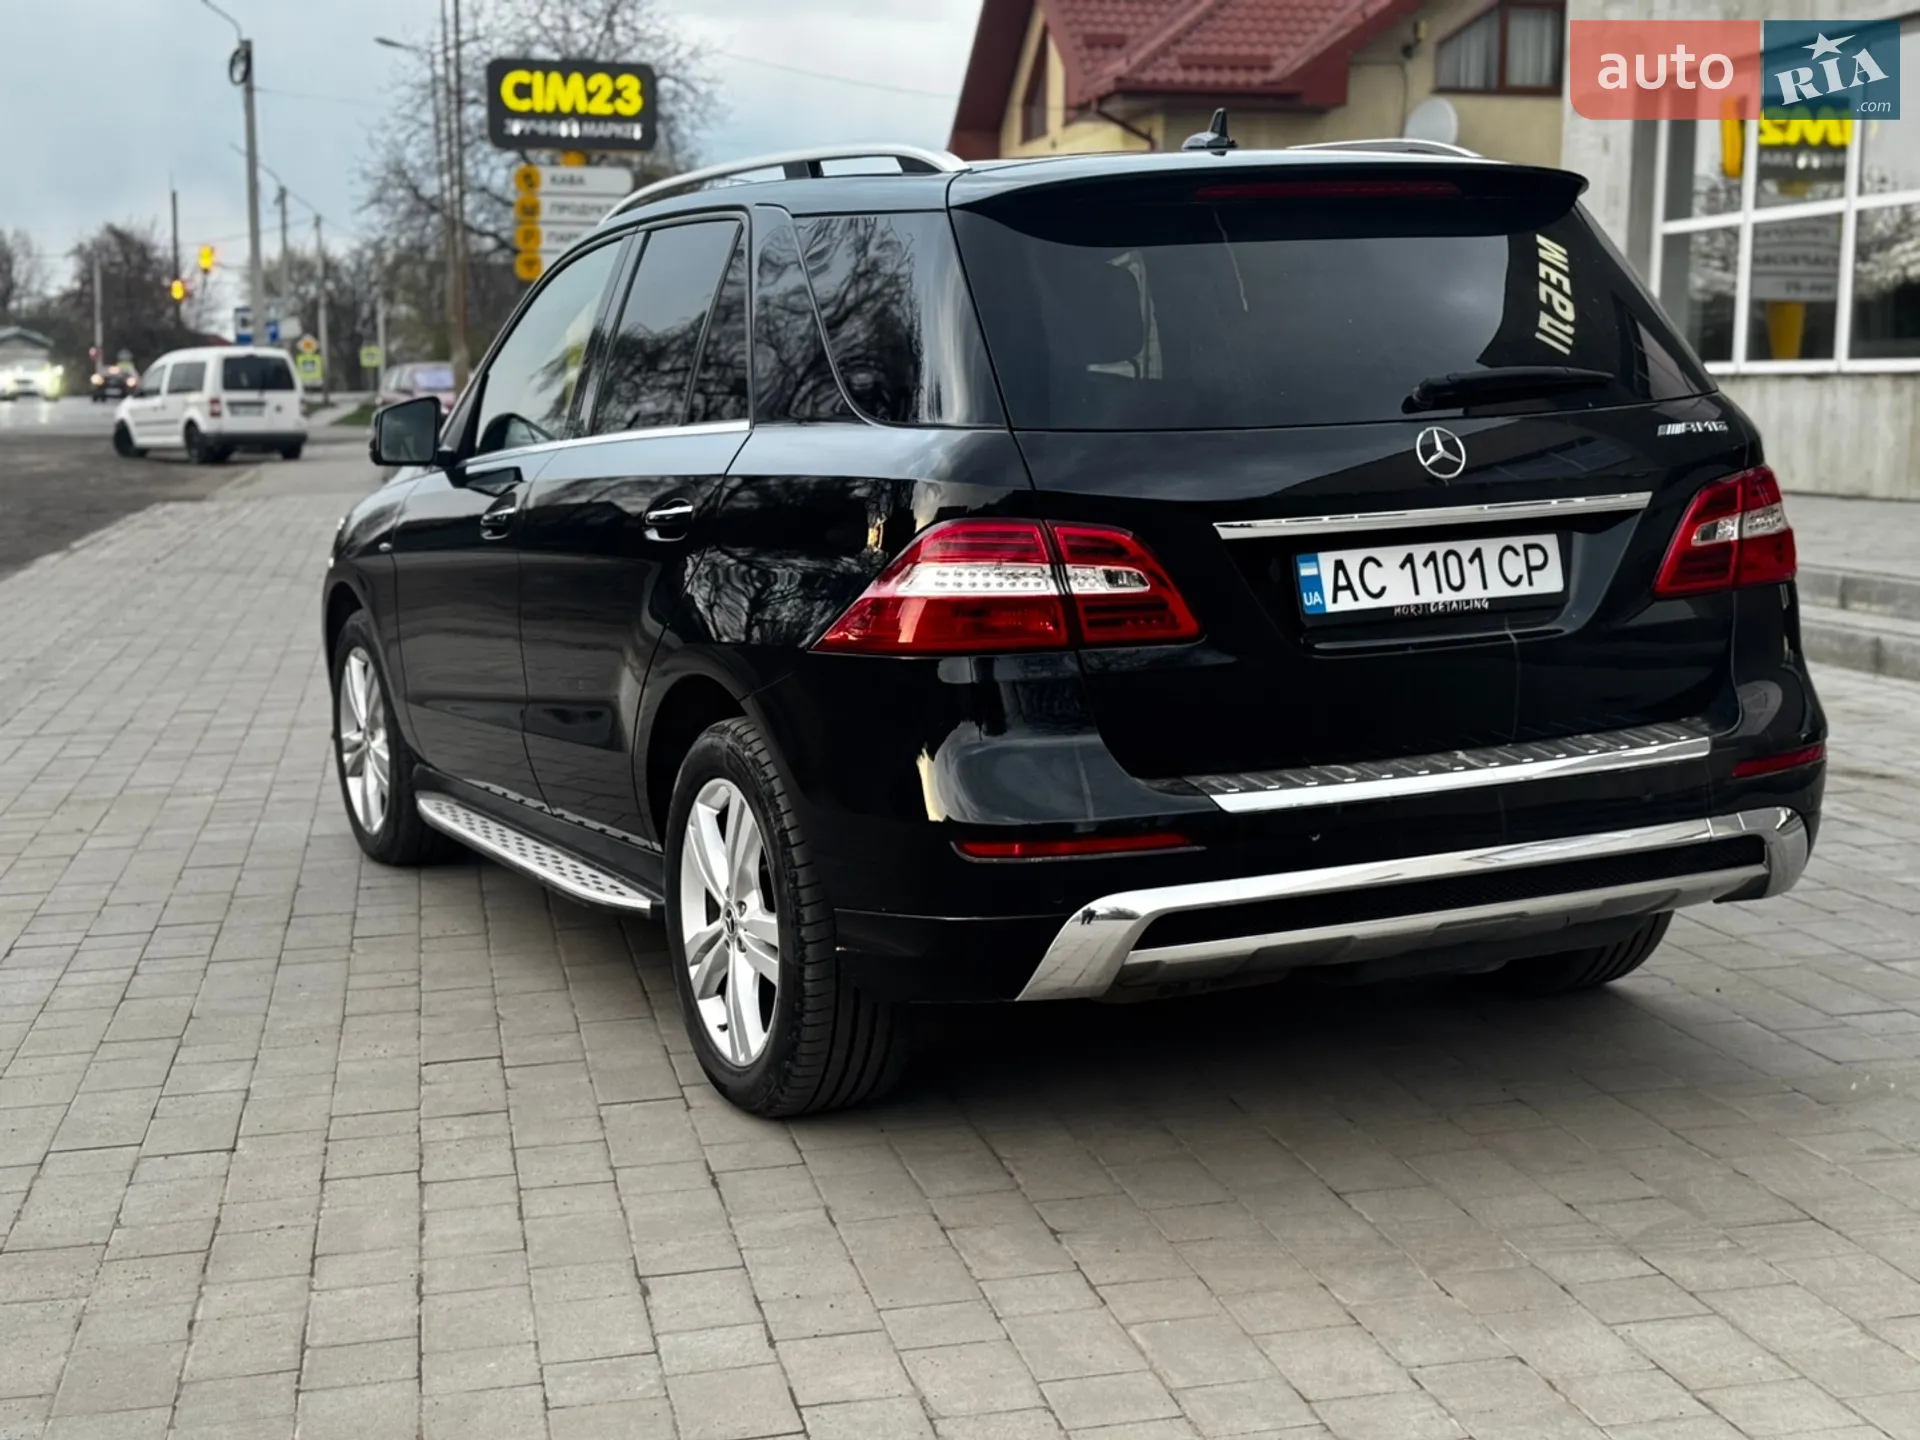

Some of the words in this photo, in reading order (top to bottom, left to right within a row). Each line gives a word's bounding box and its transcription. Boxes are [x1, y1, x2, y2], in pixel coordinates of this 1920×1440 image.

[550, 173, 586, 186] КАВА
[1331, 555, 1387, 604] AC
[1398, 547, 1488, 596] 1101
[1498, 543, 1549, 588] CP
[1303, 591, 1323, 606] UA
